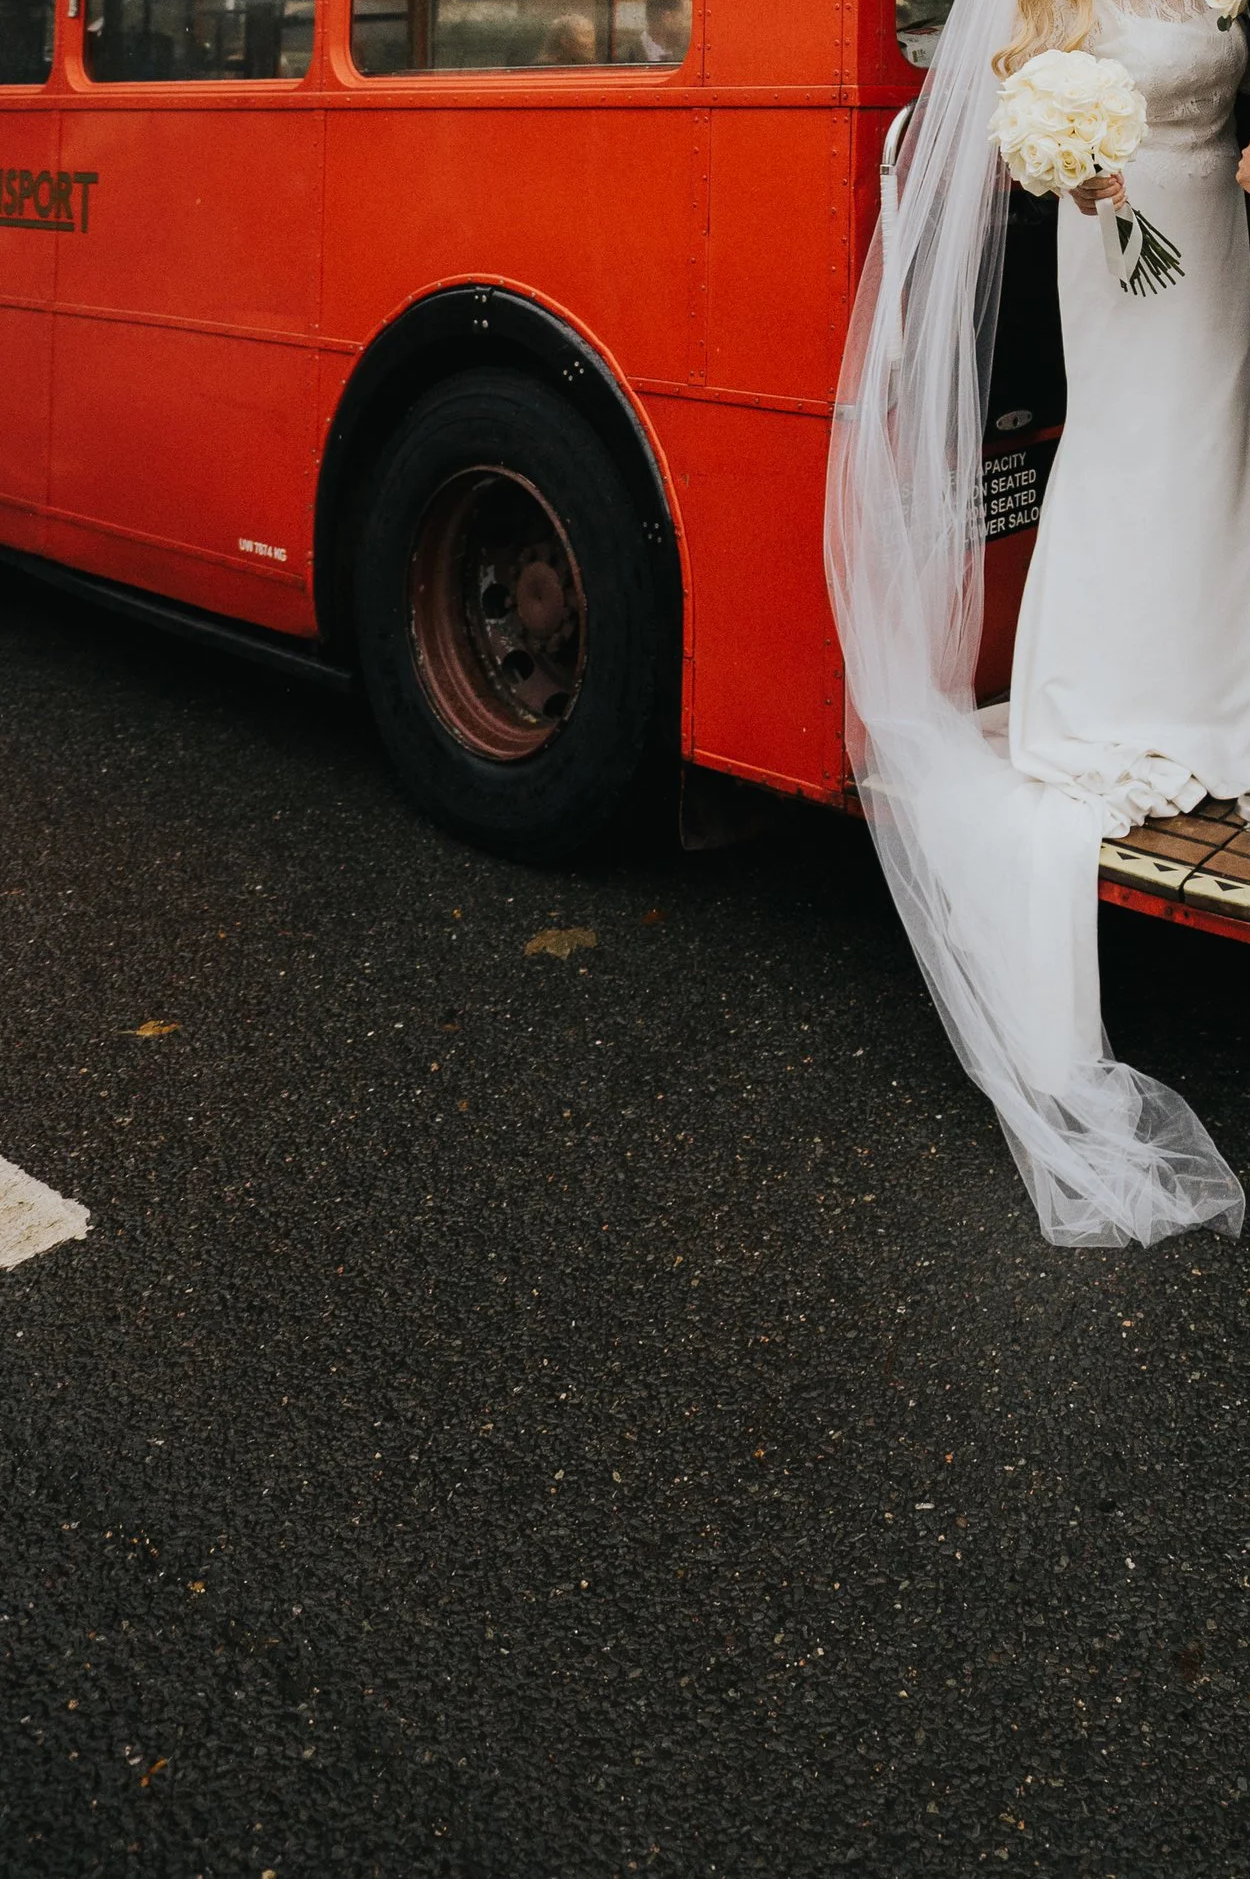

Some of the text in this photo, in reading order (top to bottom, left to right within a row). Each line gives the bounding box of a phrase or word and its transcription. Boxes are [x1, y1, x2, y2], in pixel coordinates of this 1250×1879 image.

[991, 469, 1036, 495] SEATED
[990, 489, 1036, 515] SEATED
[1009, 507, 1041, 529] SALO
